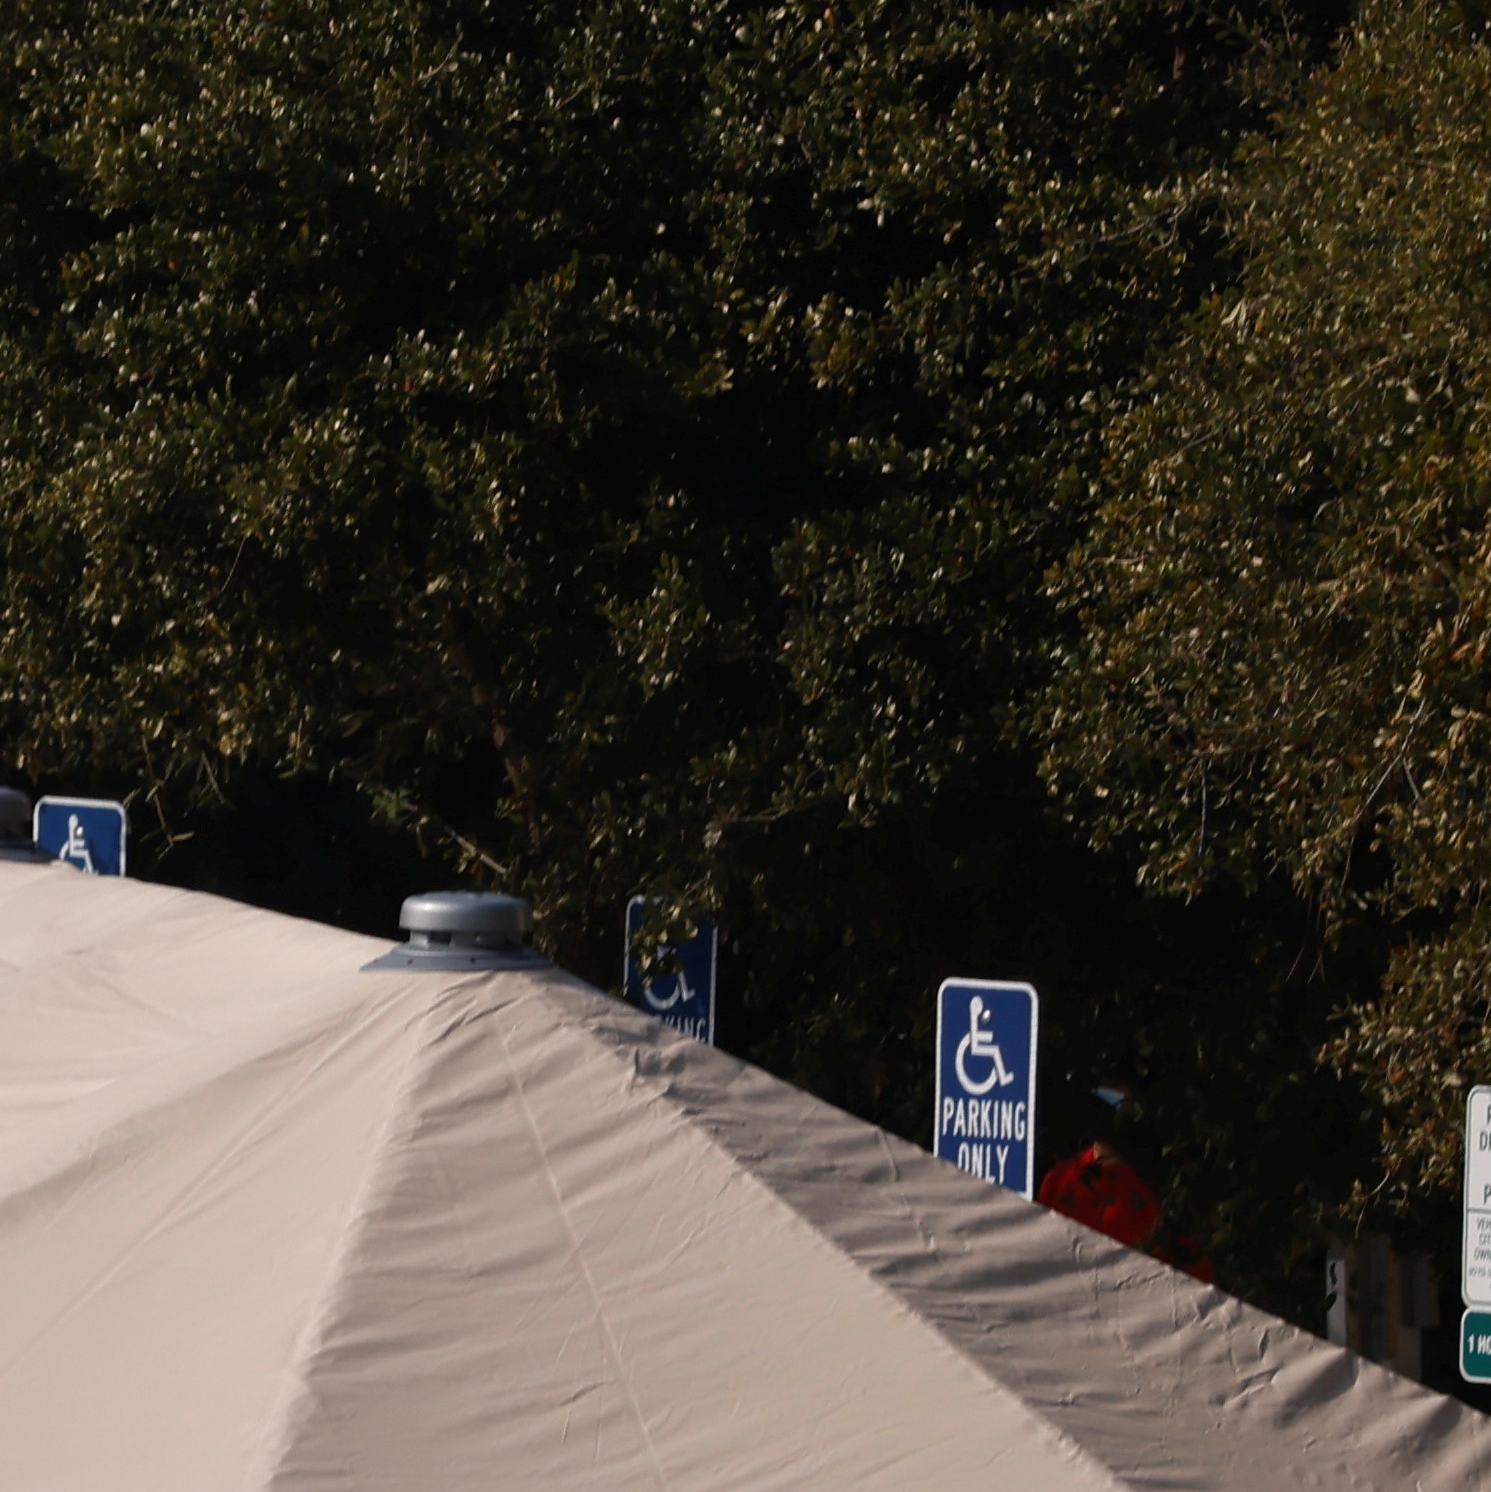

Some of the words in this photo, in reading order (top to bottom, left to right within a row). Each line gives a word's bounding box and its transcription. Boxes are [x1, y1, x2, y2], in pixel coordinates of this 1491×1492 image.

[942, 1096, 1026, 1141] PARKING
[957, 1141, 1009, 1185] ONLY
[1468, 1334, 1474, 1353] 1
